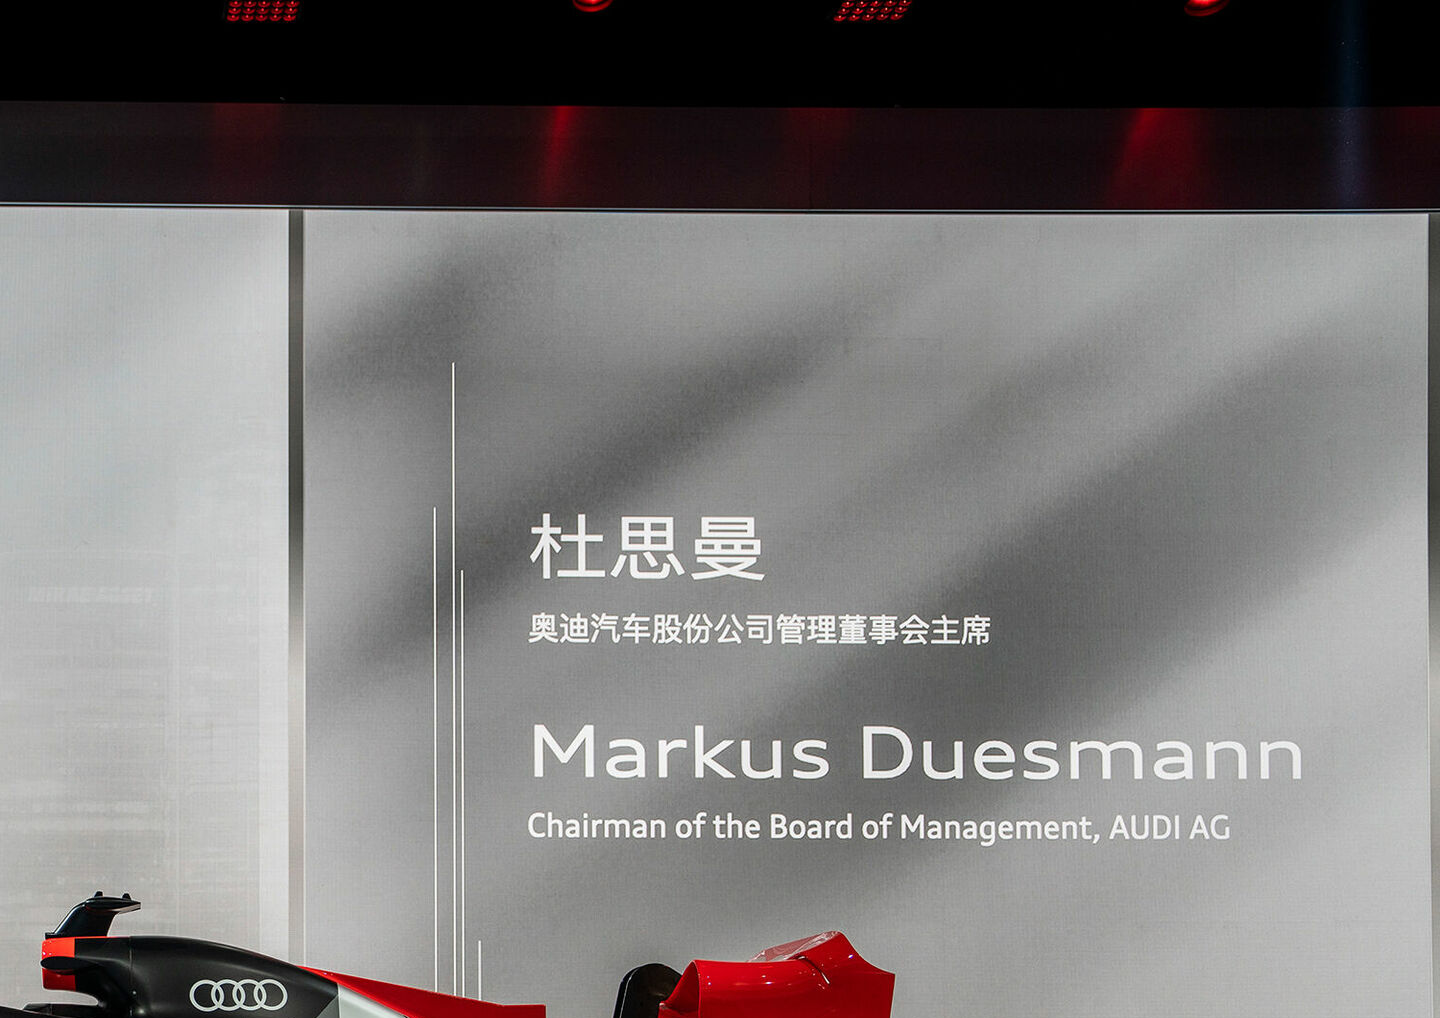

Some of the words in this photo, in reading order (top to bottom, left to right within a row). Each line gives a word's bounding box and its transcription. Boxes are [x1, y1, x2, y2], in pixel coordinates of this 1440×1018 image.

[530, 513, 766, 582] 杜思曼
[528, 613, 991, 646] 奥迪汽车股份公司管理董事会主席
[534, 725, 829, 779] Markus
[863, 726, 1303, 780] Duesmann
[528, 812, 666, 839] Chairman
[676, 812, 707, 839] of
[712, 812, 761, 839] the
[771, 813, 852, 839] Board
[862, 812, 893, 839] of
[901, 814, 1100, 847] Management,
[1109, 814, 1180, 840] AUDI
[1189, 814, 1231, 840] AG
